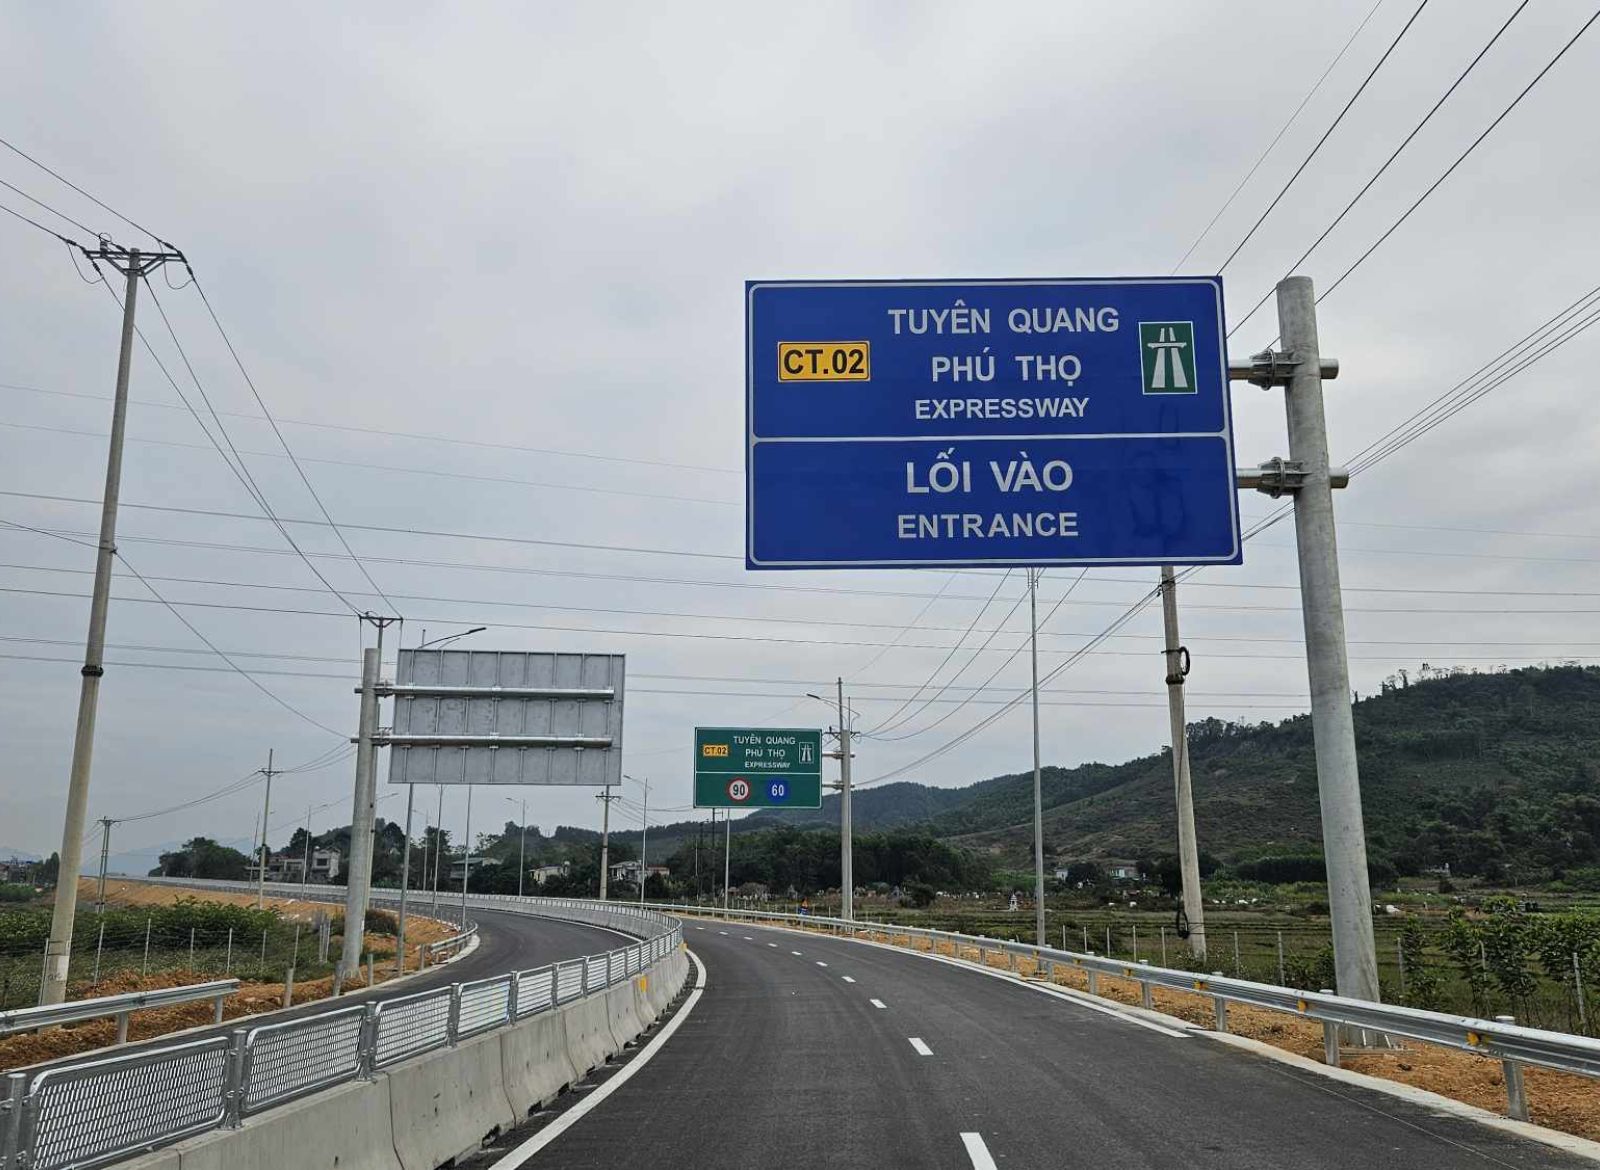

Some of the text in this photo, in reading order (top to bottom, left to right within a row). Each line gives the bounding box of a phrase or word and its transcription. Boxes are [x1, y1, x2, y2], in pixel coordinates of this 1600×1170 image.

[887, 299, 1120, 335] TUYÊN QUANG
[783, 348, 865, 375] CT.02
[932, 346, 1082, 387] PHÚ THỌ
[914, 397, 1090, 420] EXPRESSWAY
[906, 447, 1074, 493] LỐI VÀO
[897, 512, 1079, 538] ENTRANCE
[733, 734, 795, 745] TUYÊN QUANG
[704, 746, 727, 755] CT.02
[768, 748, 786, 759] THỌ
[744, 761, 791, 769] EXPRESSWAY
[733, 784, 746, 796] 90
[771, 784, 785, 796] 60
